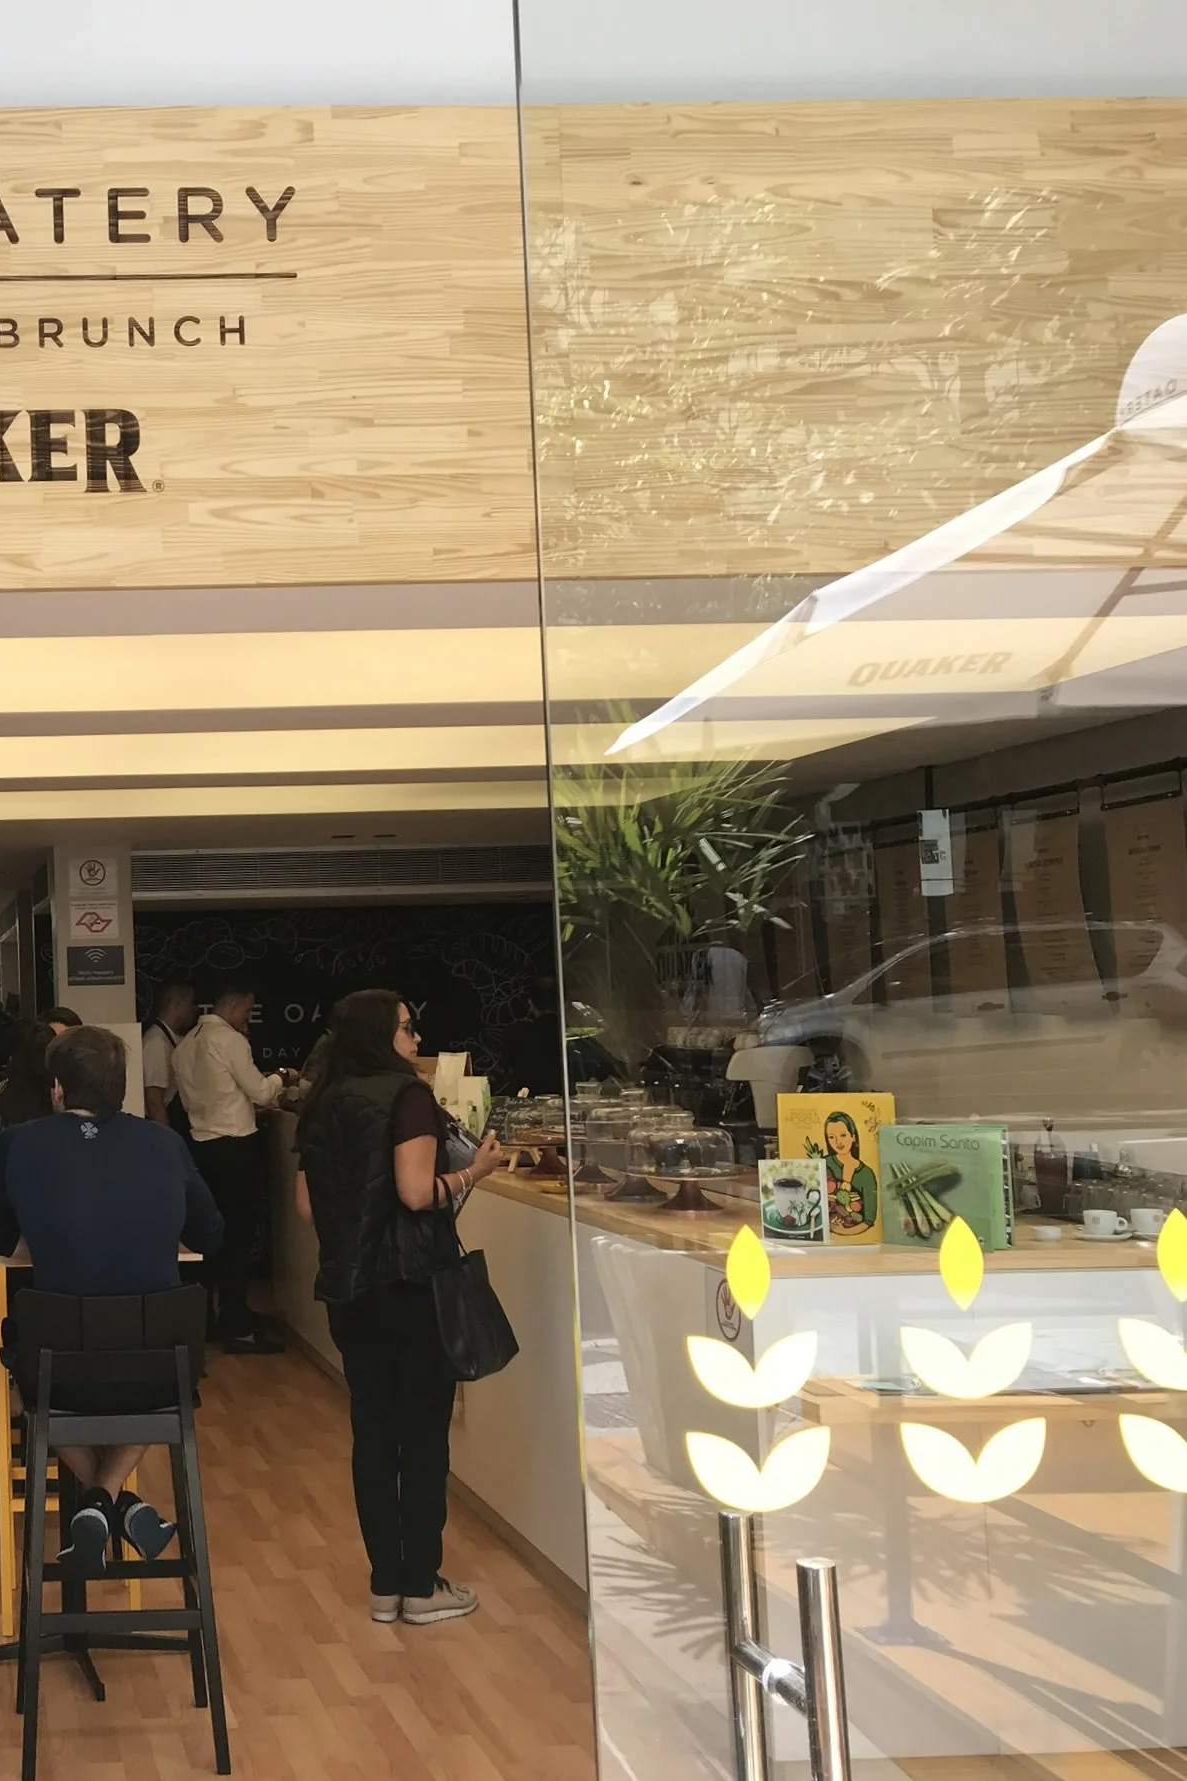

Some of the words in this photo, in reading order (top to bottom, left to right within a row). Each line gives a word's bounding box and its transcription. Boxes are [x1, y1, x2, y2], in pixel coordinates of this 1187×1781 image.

[847, 652, 1013, 687] QUAKER
[263, 1047, 301, 1059] DAY
[896, 1131, 936, 1150] Capim
[939, 1133, 981, 1151] Santo
